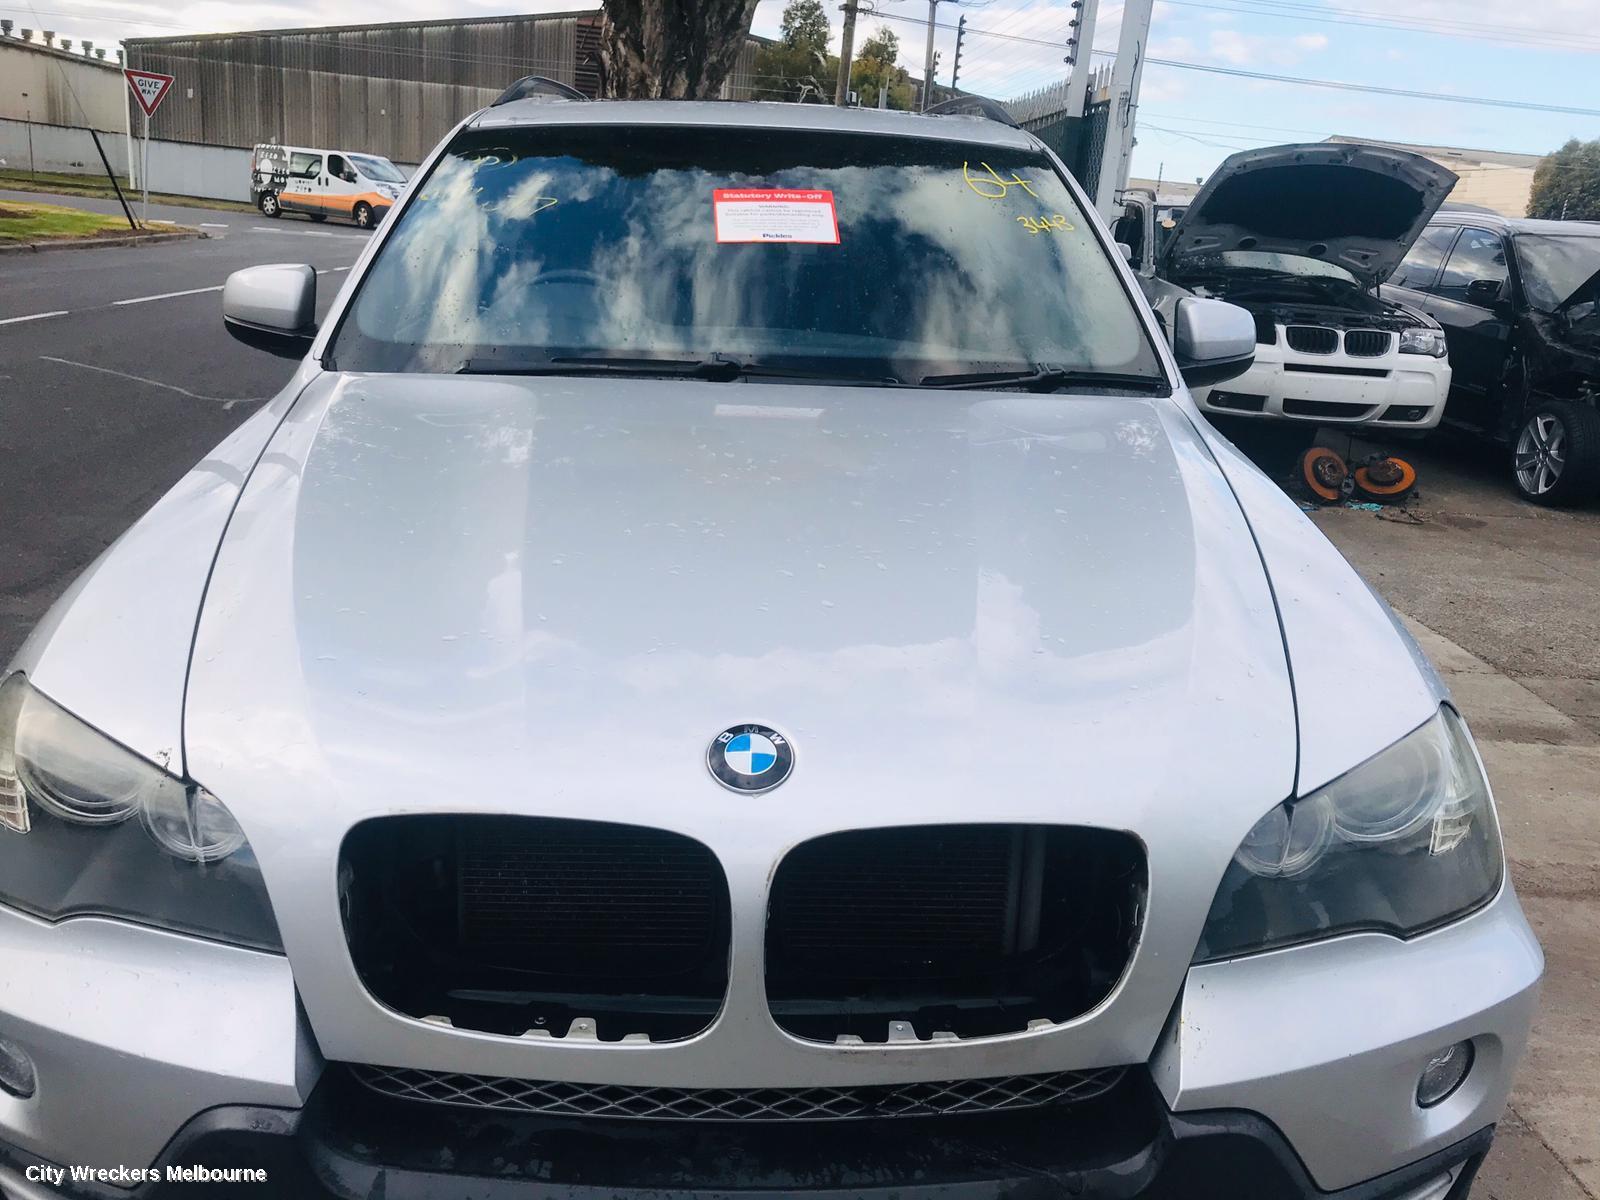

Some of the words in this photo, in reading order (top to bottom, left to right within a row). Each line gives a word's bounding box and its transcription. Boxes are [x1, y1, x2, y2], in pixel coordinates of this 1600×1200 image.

[138, 79, 160, 89] GIVE
[963, 161, 1039, 199] 64
[722, 192, 772, 200] Statutory
[773, 192, 823, 200] Write-Off
[717, 726, 786, 745] BMW
